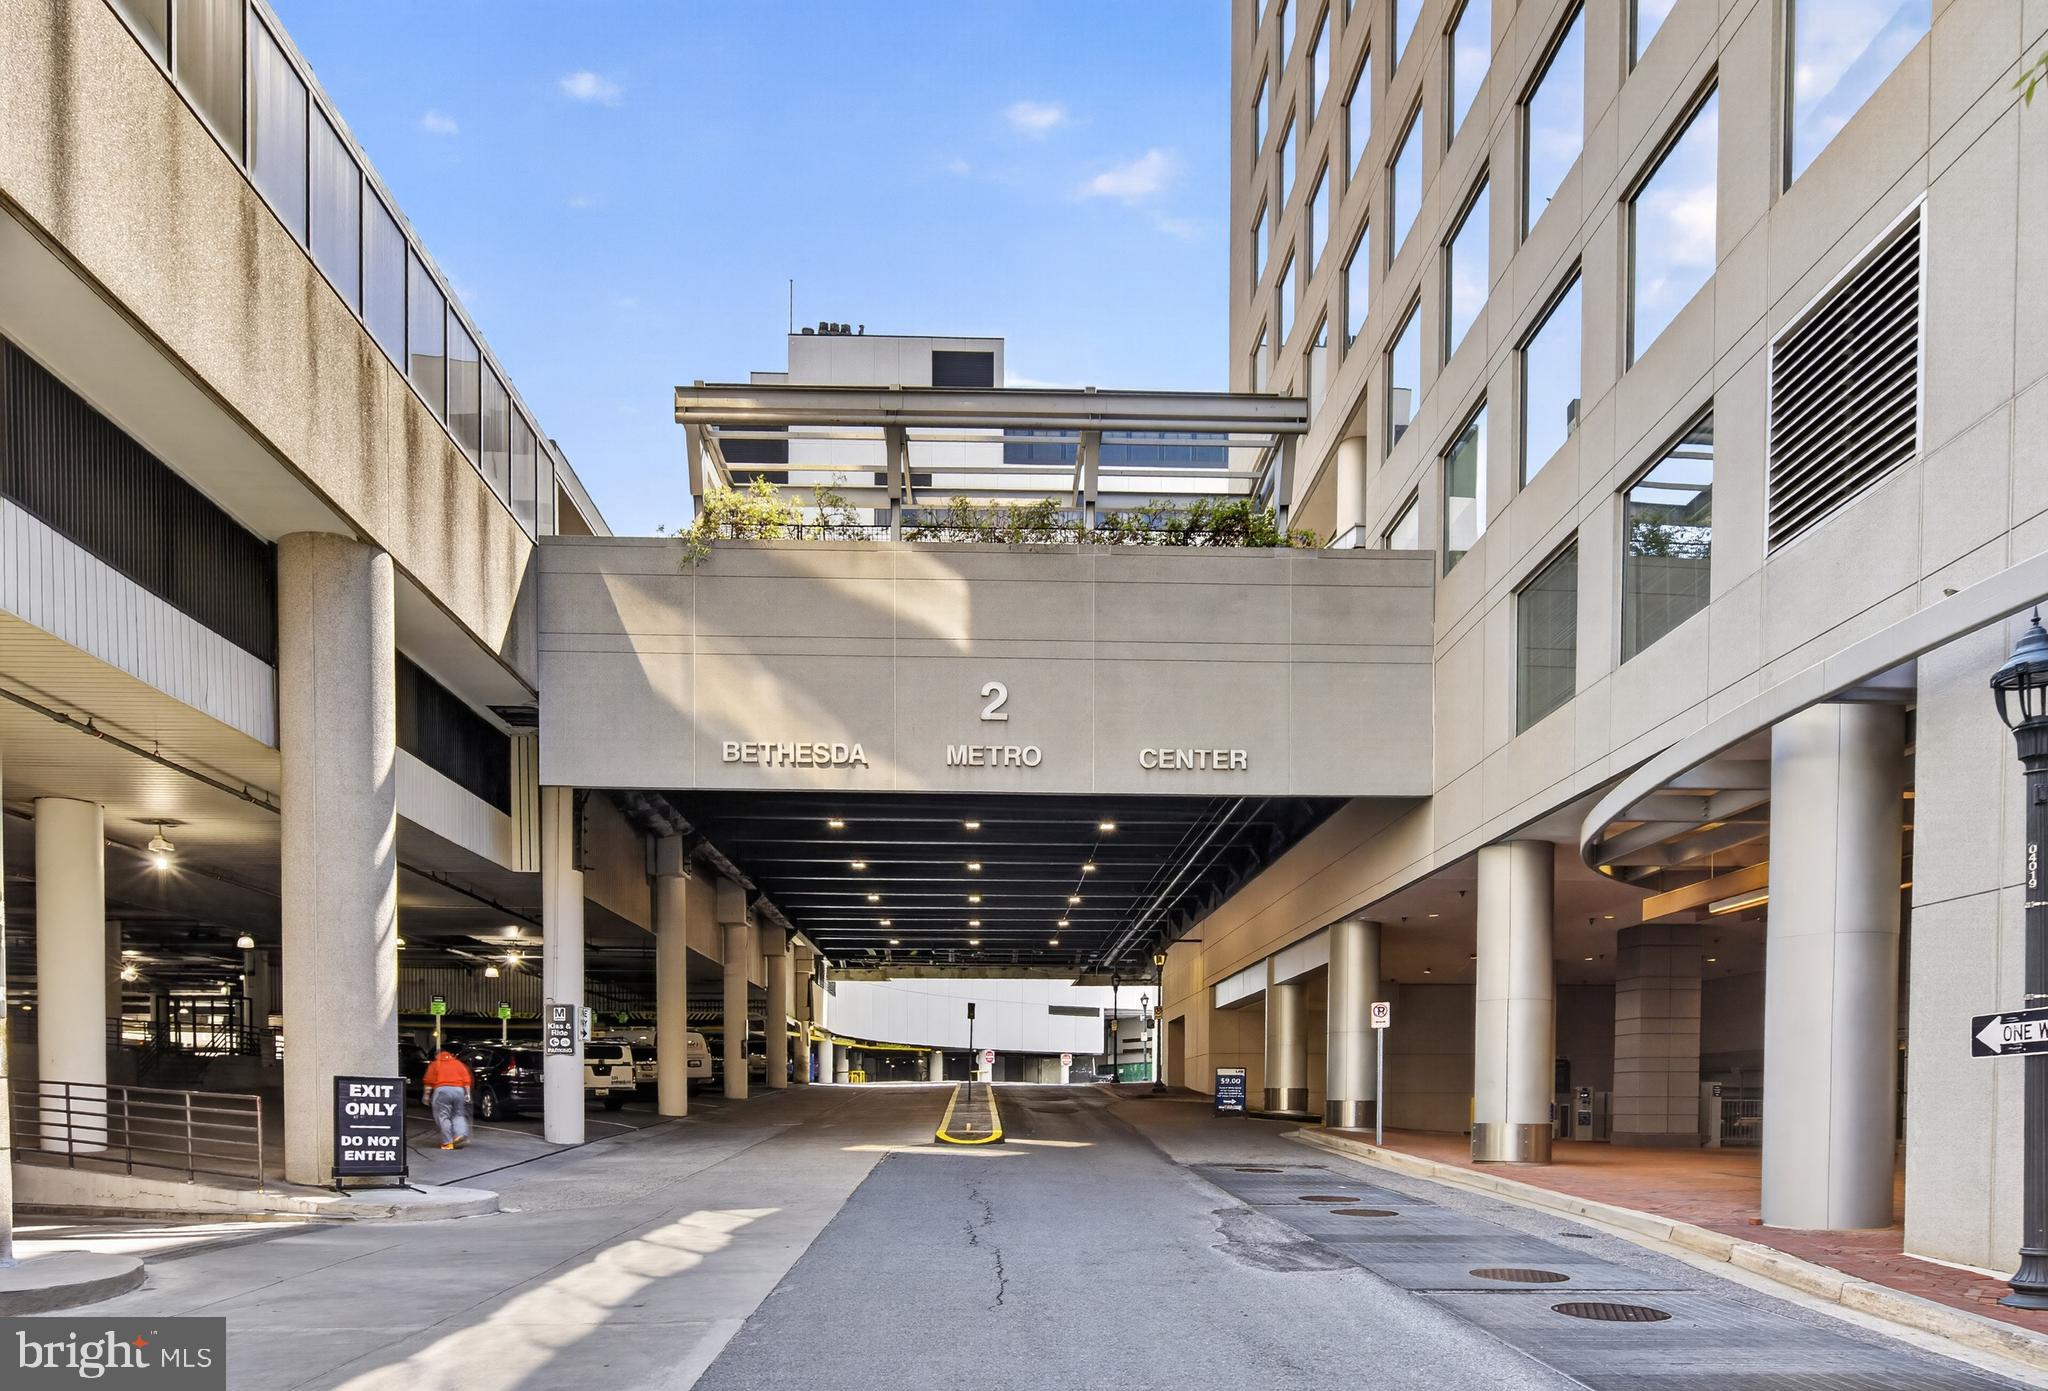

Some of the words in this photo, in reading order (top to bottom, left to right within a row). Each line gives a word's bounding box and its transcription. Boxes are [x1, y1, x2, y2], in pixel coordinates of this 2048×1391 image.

[980, 681, 1009, 722] 2
[722, 741, 868, 766] BETHESDA
[946, 744, 1042, 767] METRO
[1139, 748, 1248, 770] CENTER
[2028, 844, 2038, 889] 04019
[2003, 1023, 2032, 1042] ONE
[349, 1083, 394, 1098] EXIT
[345, 1102, 398, 1116] ONLY
[341, 1135, 363, 1146] DO
[367, 1136, 400, 1147] NOT
[344, 1150, 396, 1161] ENTER
